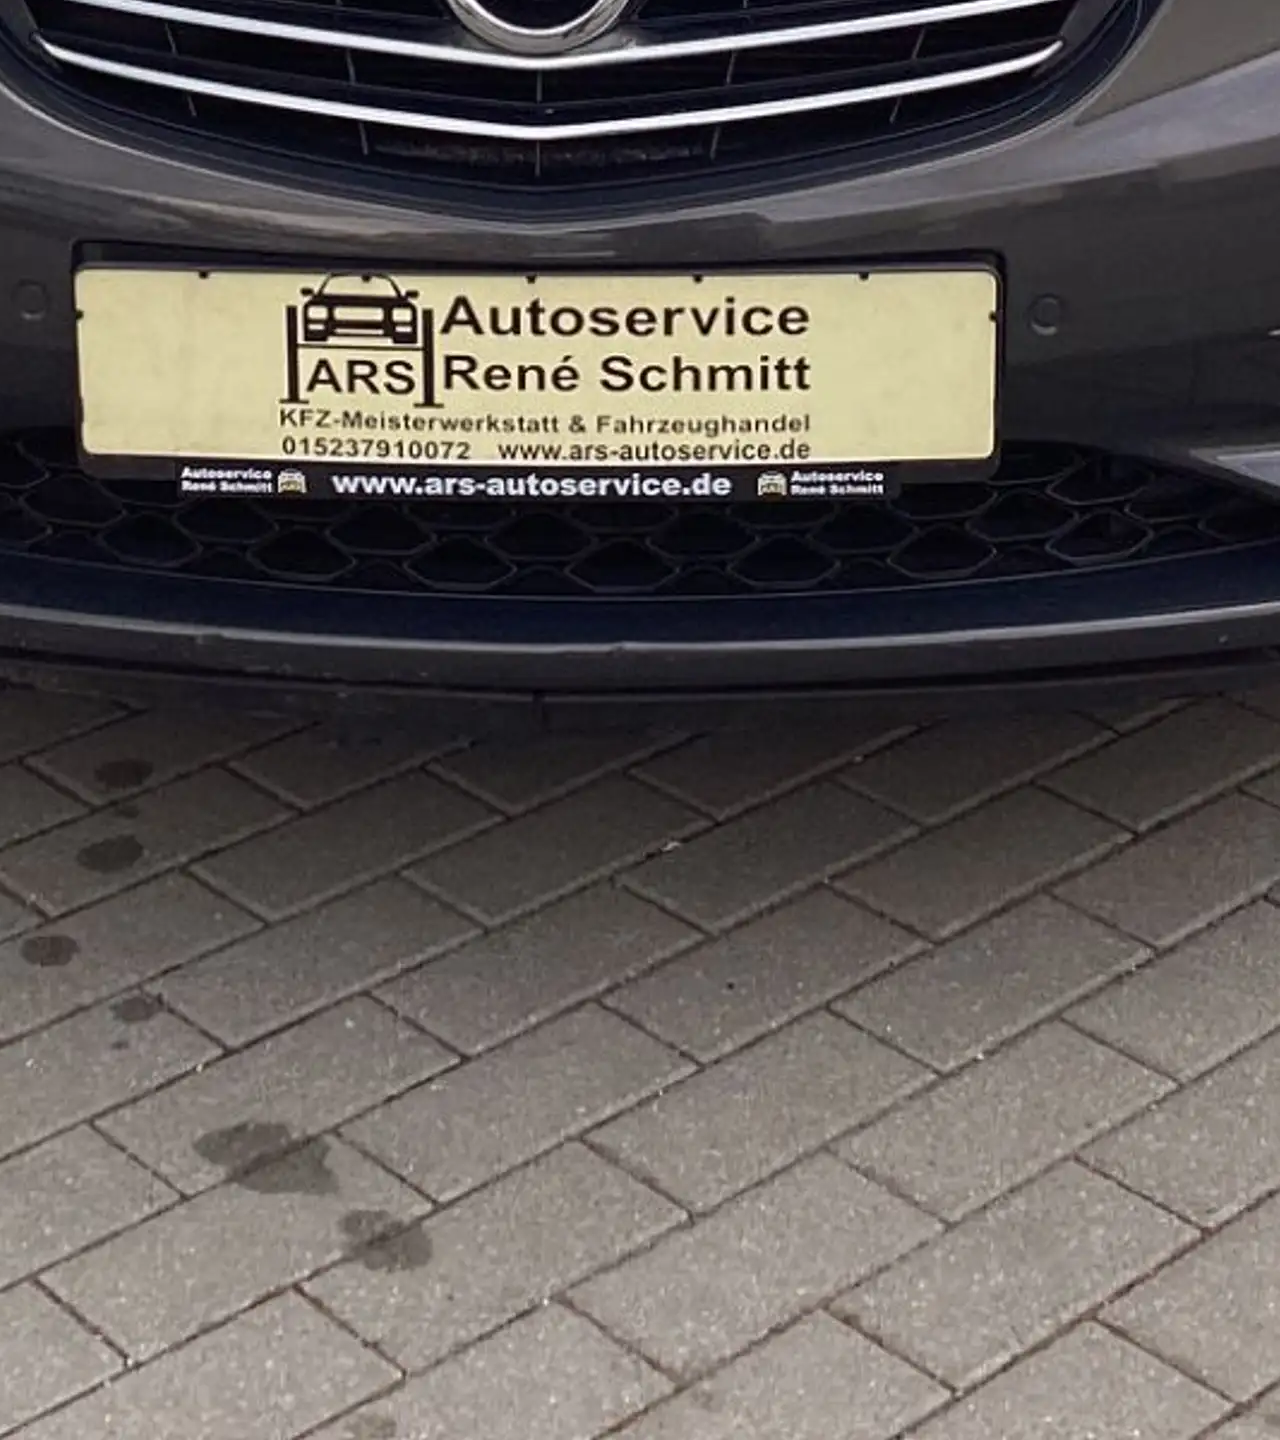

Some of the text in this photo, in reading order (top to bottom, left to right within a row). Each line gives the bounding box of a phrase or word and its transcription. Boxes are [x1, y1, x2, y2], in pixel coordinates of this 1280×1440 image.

[441, 295, 810, 337] Autoservice
[307, 359, 416, 395] ARS
[444, 354, 810, 391] René Schmitt
[279, 409, 810, 437] KFZ-Meisterwerkstatt & Fahrzeughandel
[281, 437, 810, 461] 015237910072 www.ars-autoservice.de
[332, 472, 732, 497] www.ars-autoservice.de
